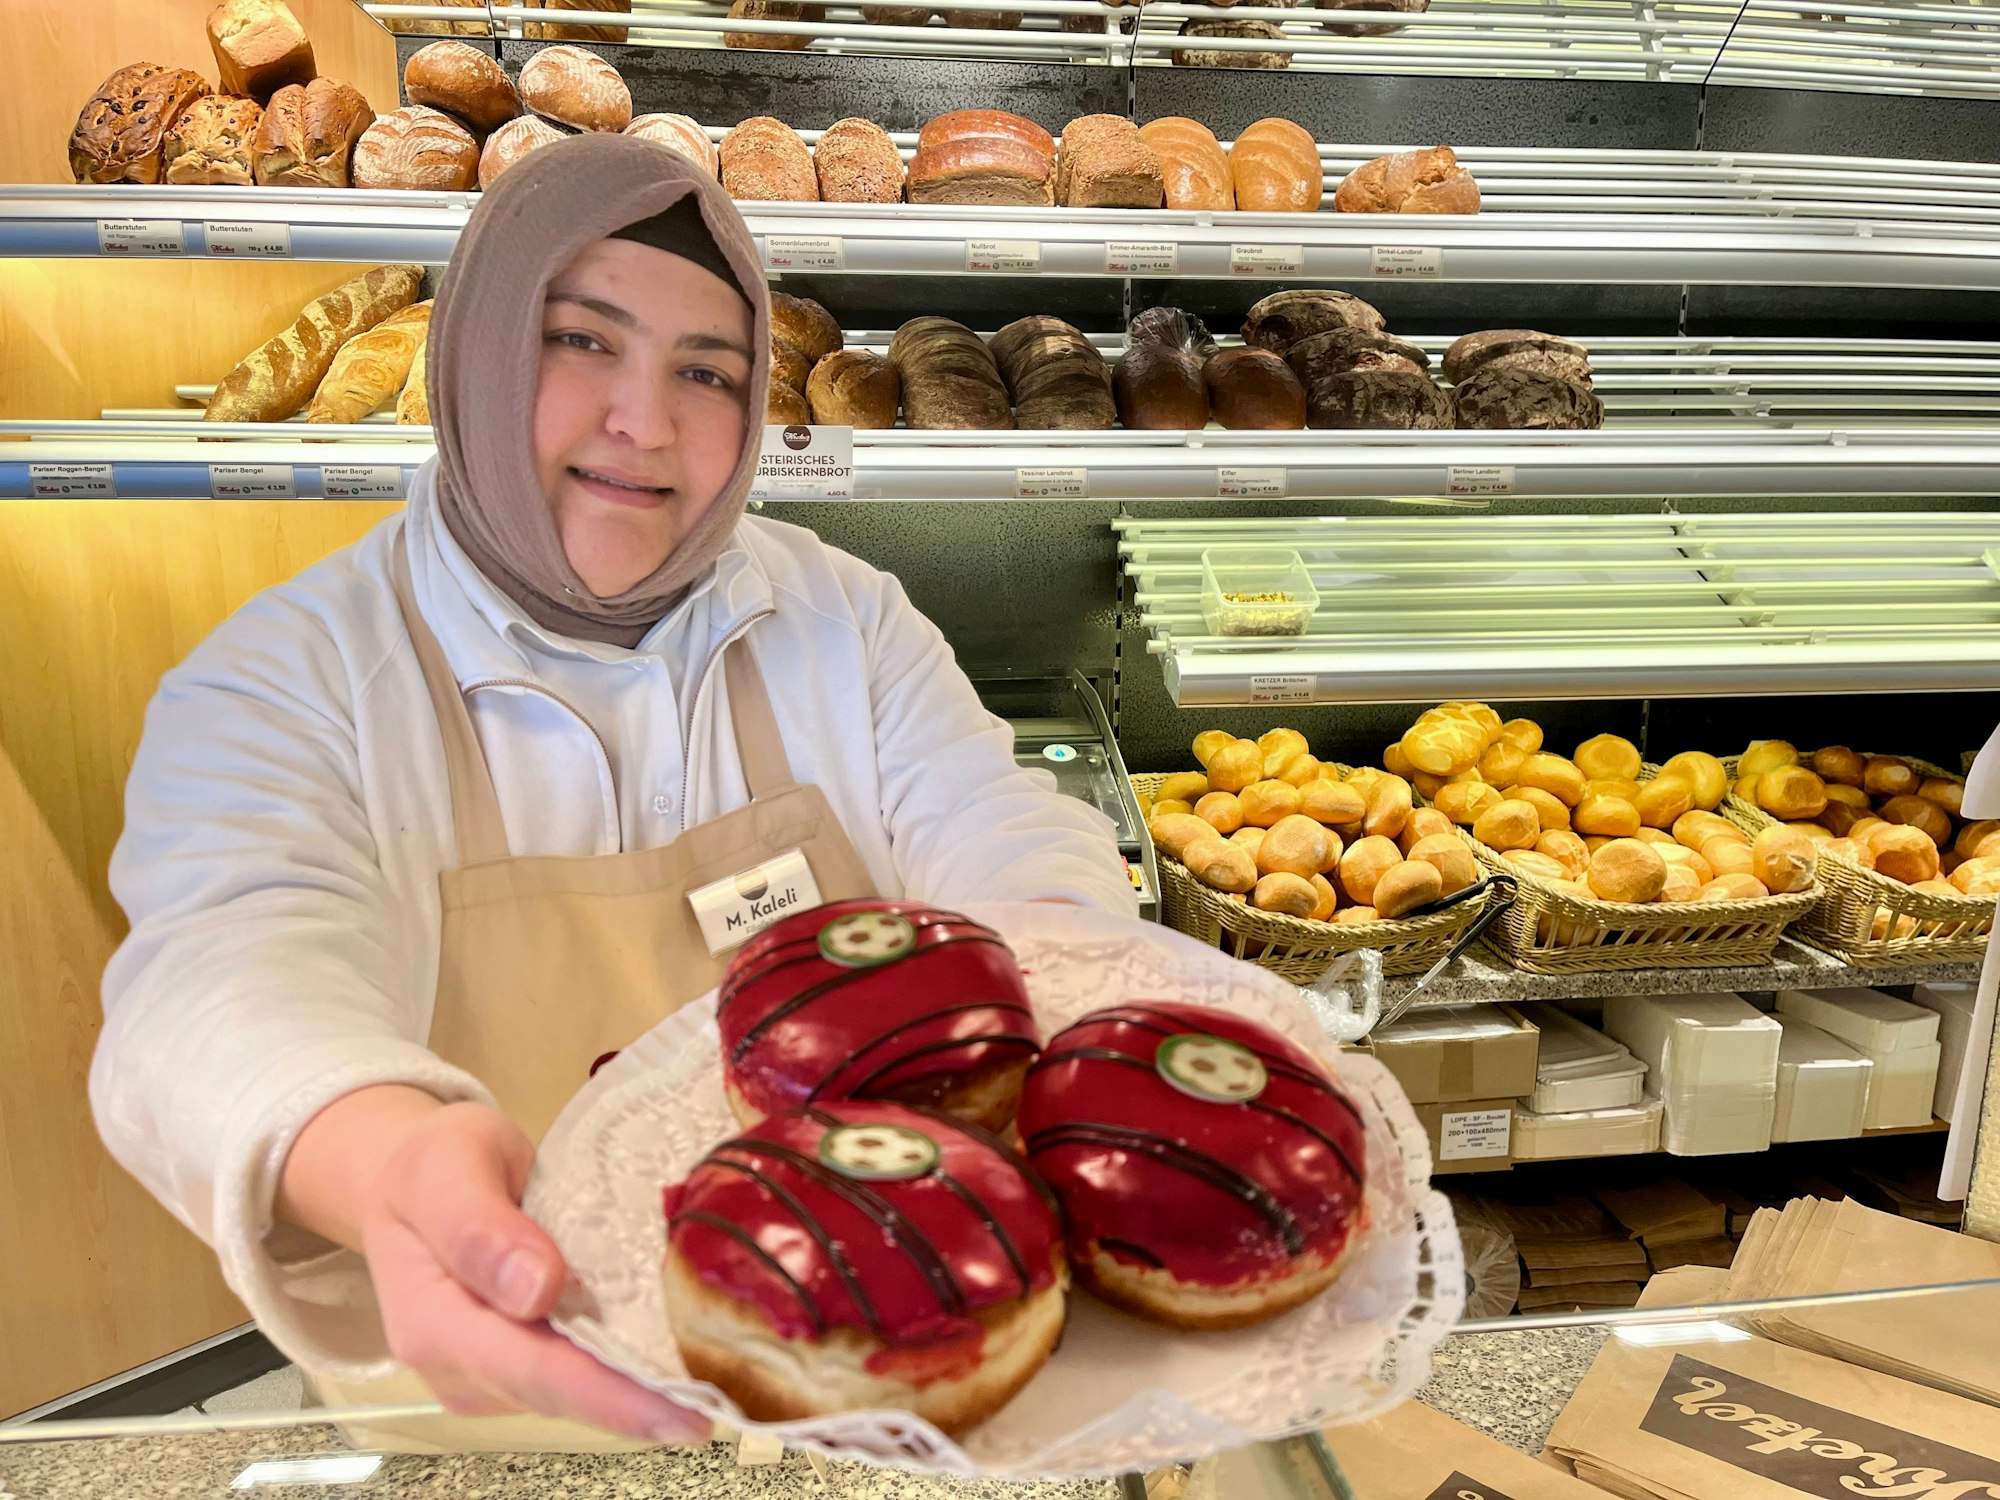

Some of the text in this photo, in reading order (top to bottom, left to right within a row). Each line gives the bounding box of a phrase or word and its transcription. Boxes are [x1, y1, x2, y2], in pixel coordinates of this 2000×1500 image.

[761, 455, 835, 464] STEIRISCHES
[756, 465, 851, 476] ÜRBISKERNBROT
[725, 910, 747, 931] M.
[751, 888, 797, 920] Kaleli
